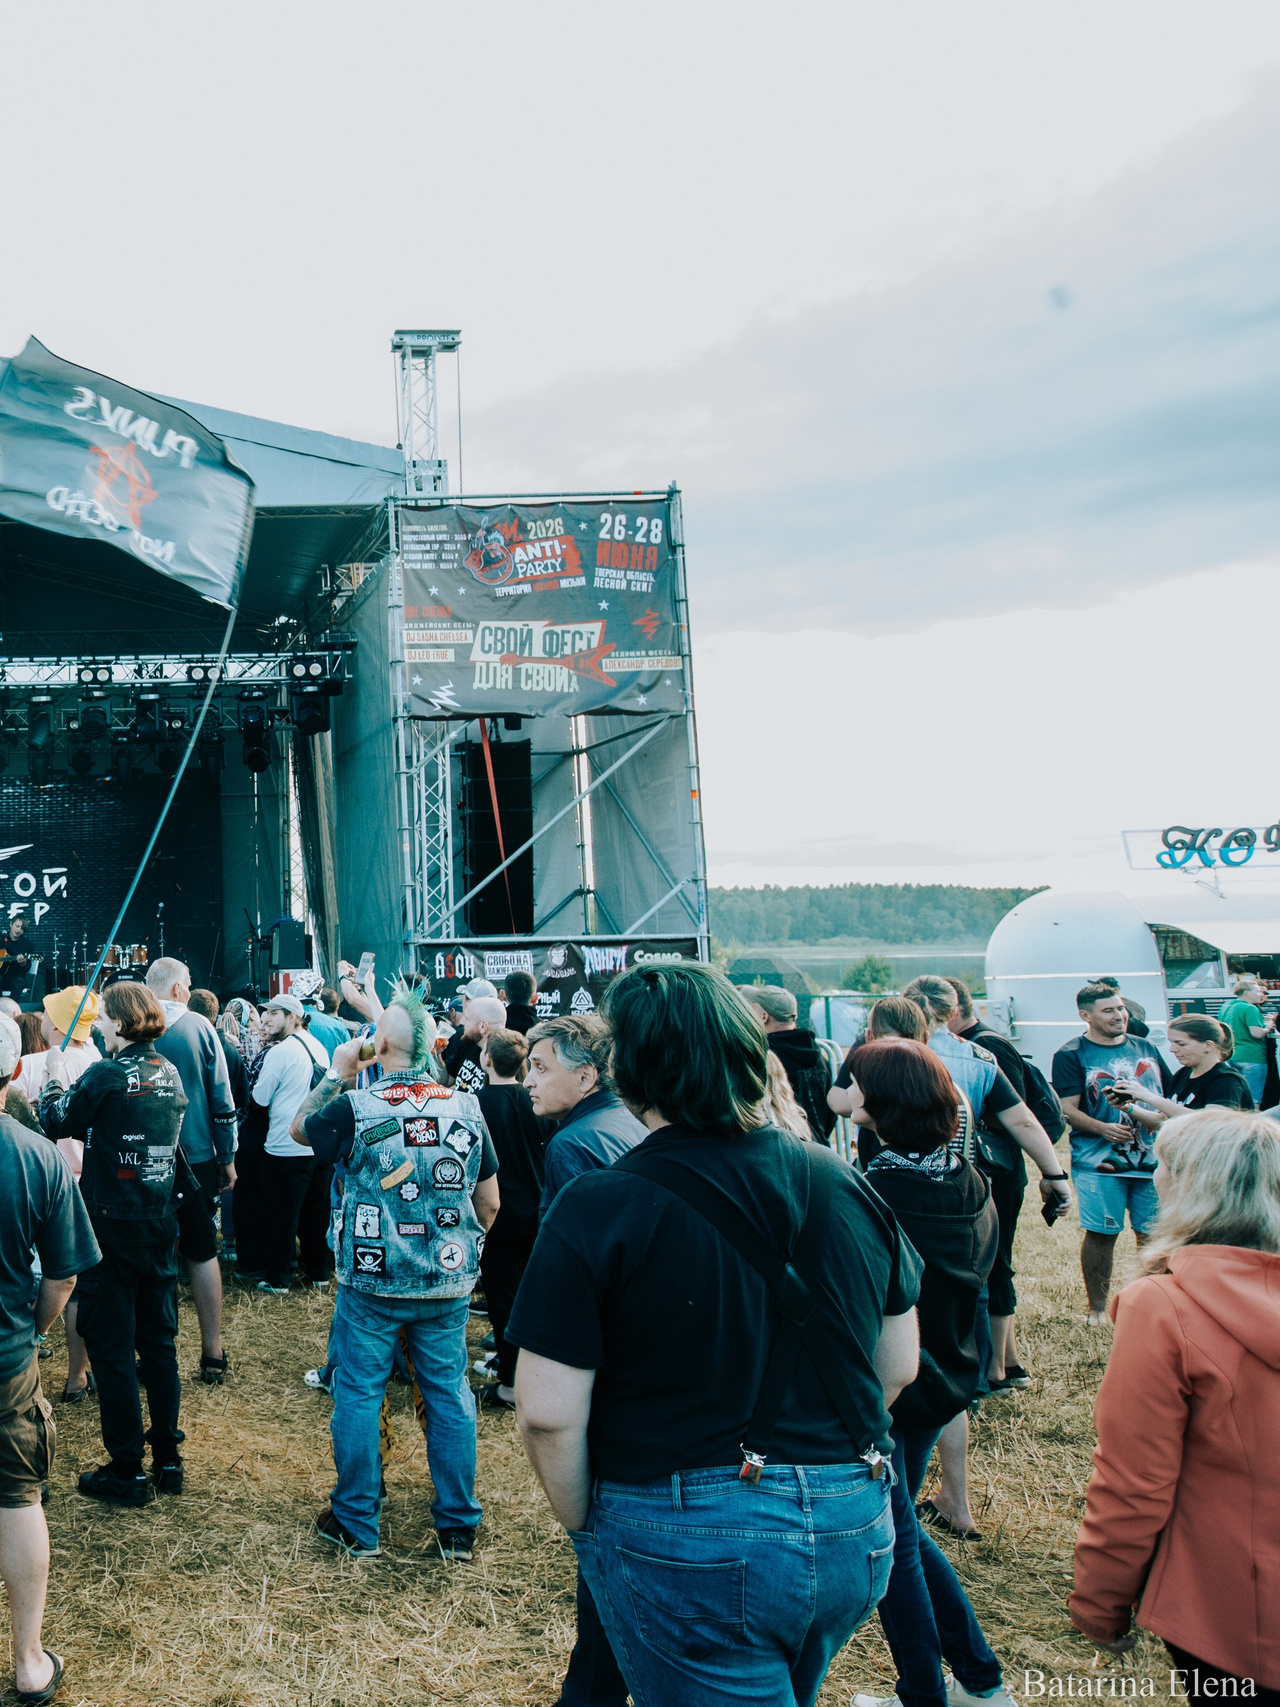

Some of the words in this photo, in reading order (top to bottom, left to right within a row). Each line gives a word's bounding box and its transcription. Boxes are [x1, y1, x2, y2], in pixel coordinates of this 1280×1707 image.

[526, 517, 565, 540] 2026
[514, 539, 567, 563] ANTI-
[596, 540, 658, 571] ИЮНЯ
[515, 558, 563, 578] PARTY
[593, 576, 627, 591] ЛЕСНОЙ
[416, 632, 438, 642] SASHA
[439, 632, 468, 642] CHELSEA
[480, 623, 534, 657] СВОЙ
[418, 650, 430, 660] LEO
[432, 650, 449, 660] TRUE
[604, 659, 645, 670] АЛЕКСАНДР
[472, 661, 513, 691] ДЛЯ
[487, 954, 529, 966] СВОБОДА
